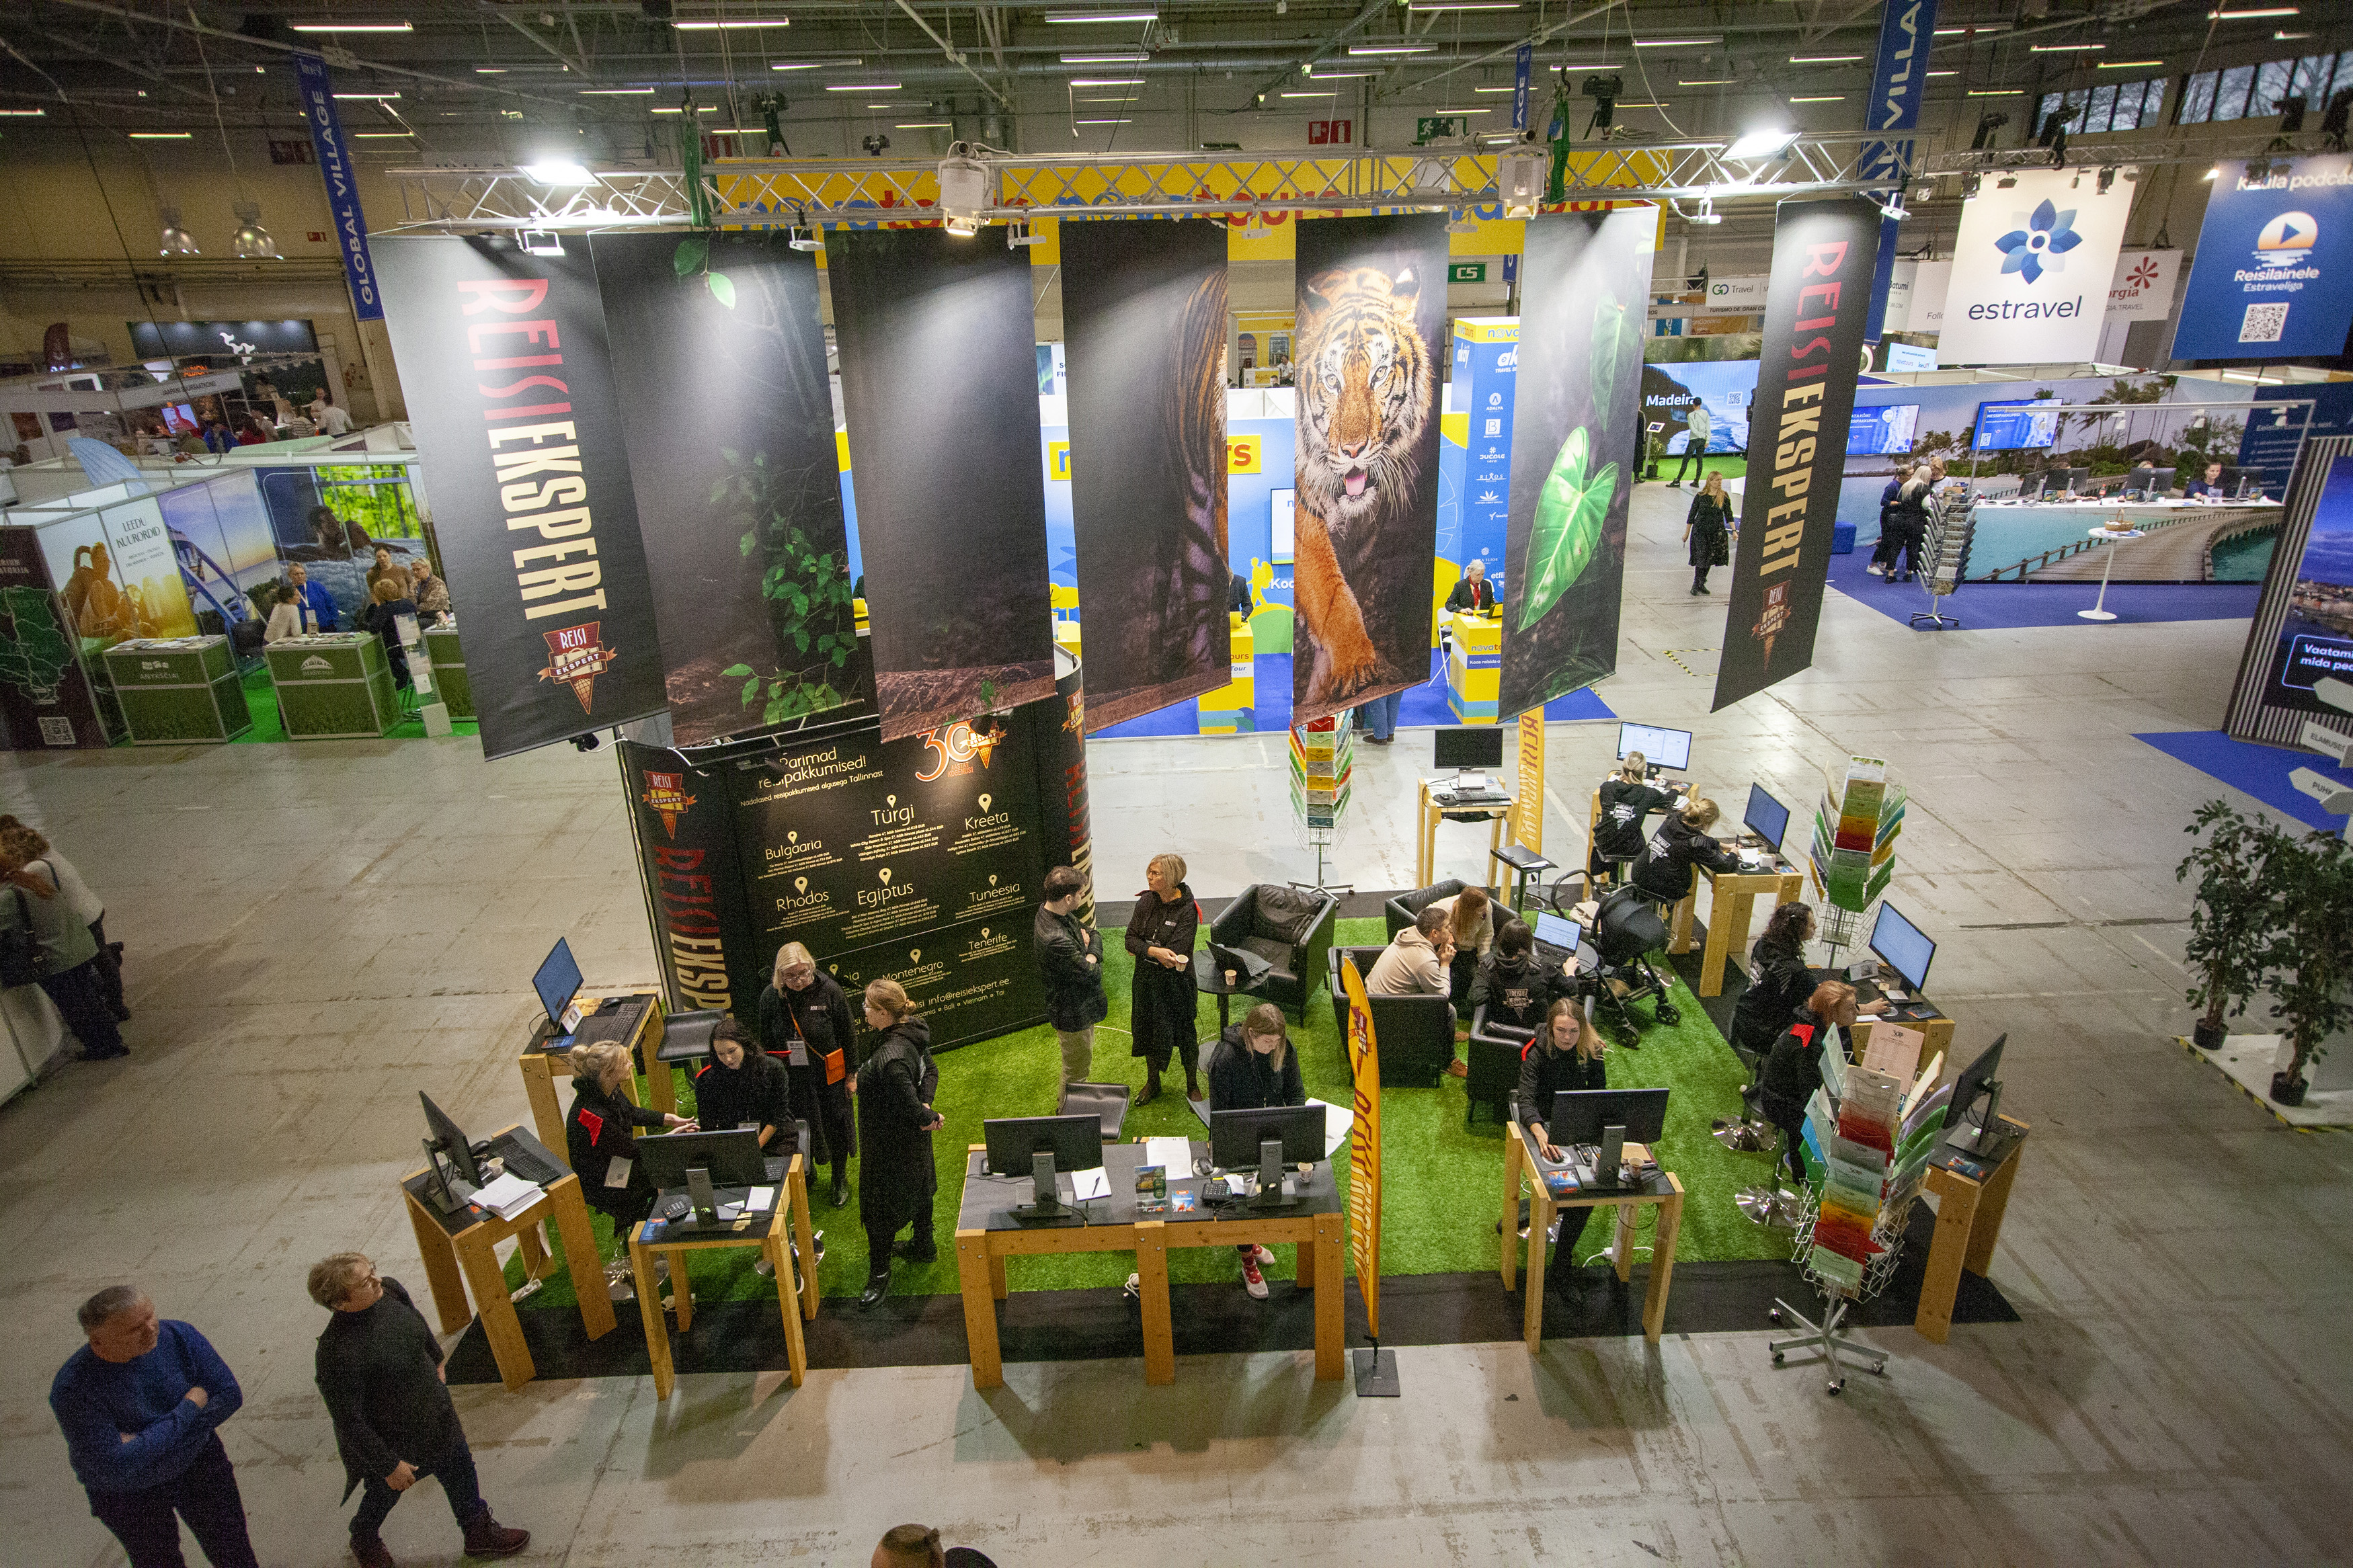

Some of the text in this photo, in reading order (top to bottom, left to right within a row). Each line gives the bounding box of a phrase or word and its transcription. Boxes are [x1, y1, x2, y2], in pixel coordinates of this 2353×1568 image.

[312, 90, 373, 305] GLOBAL VILLAGE
[1456, 267, 1478, 279] C5
[2234, 266, 2320, 282] Reisilainele
[1731, 285, 1754, 294] Travel
[2243, 282, 2303, 292] Estraveliga
[1968, 295, 2083, 321] estravel
[1646, 393, 1696, 407] Madeira
[122, 516, 147, 532] LEEDU
[116, 526, 161, 548] KUURORDID
[559, 628, 588, 649] REISI
[556, 653, 600, 675] EKSPERT
[2300, 657, 2331, 669] mida
[653, 774, 672, 788] REISI
[774, 784, 820, 800] reisipakkumised
[821, 779, 848, 790] algusega
[849, 770, 884, 784] Tallinnast
[871, 804, 914, 827] Türgi
[965, 812, 1008, 831] Kreeta
[765, 840, 822, 860] Bulgaaria
[776, 890, 829, 911] Rhodos
[857, 883, 914, 908] Egiptus
[969, 883, 1020, 902] Tuneesia
[968, 933, 1008, 950] Tenerife
[882, 961, 944, 981] Montenegro
[943, 1002, 955, 1012] Bali
[963, 995, 988, 1006] Vietnam
